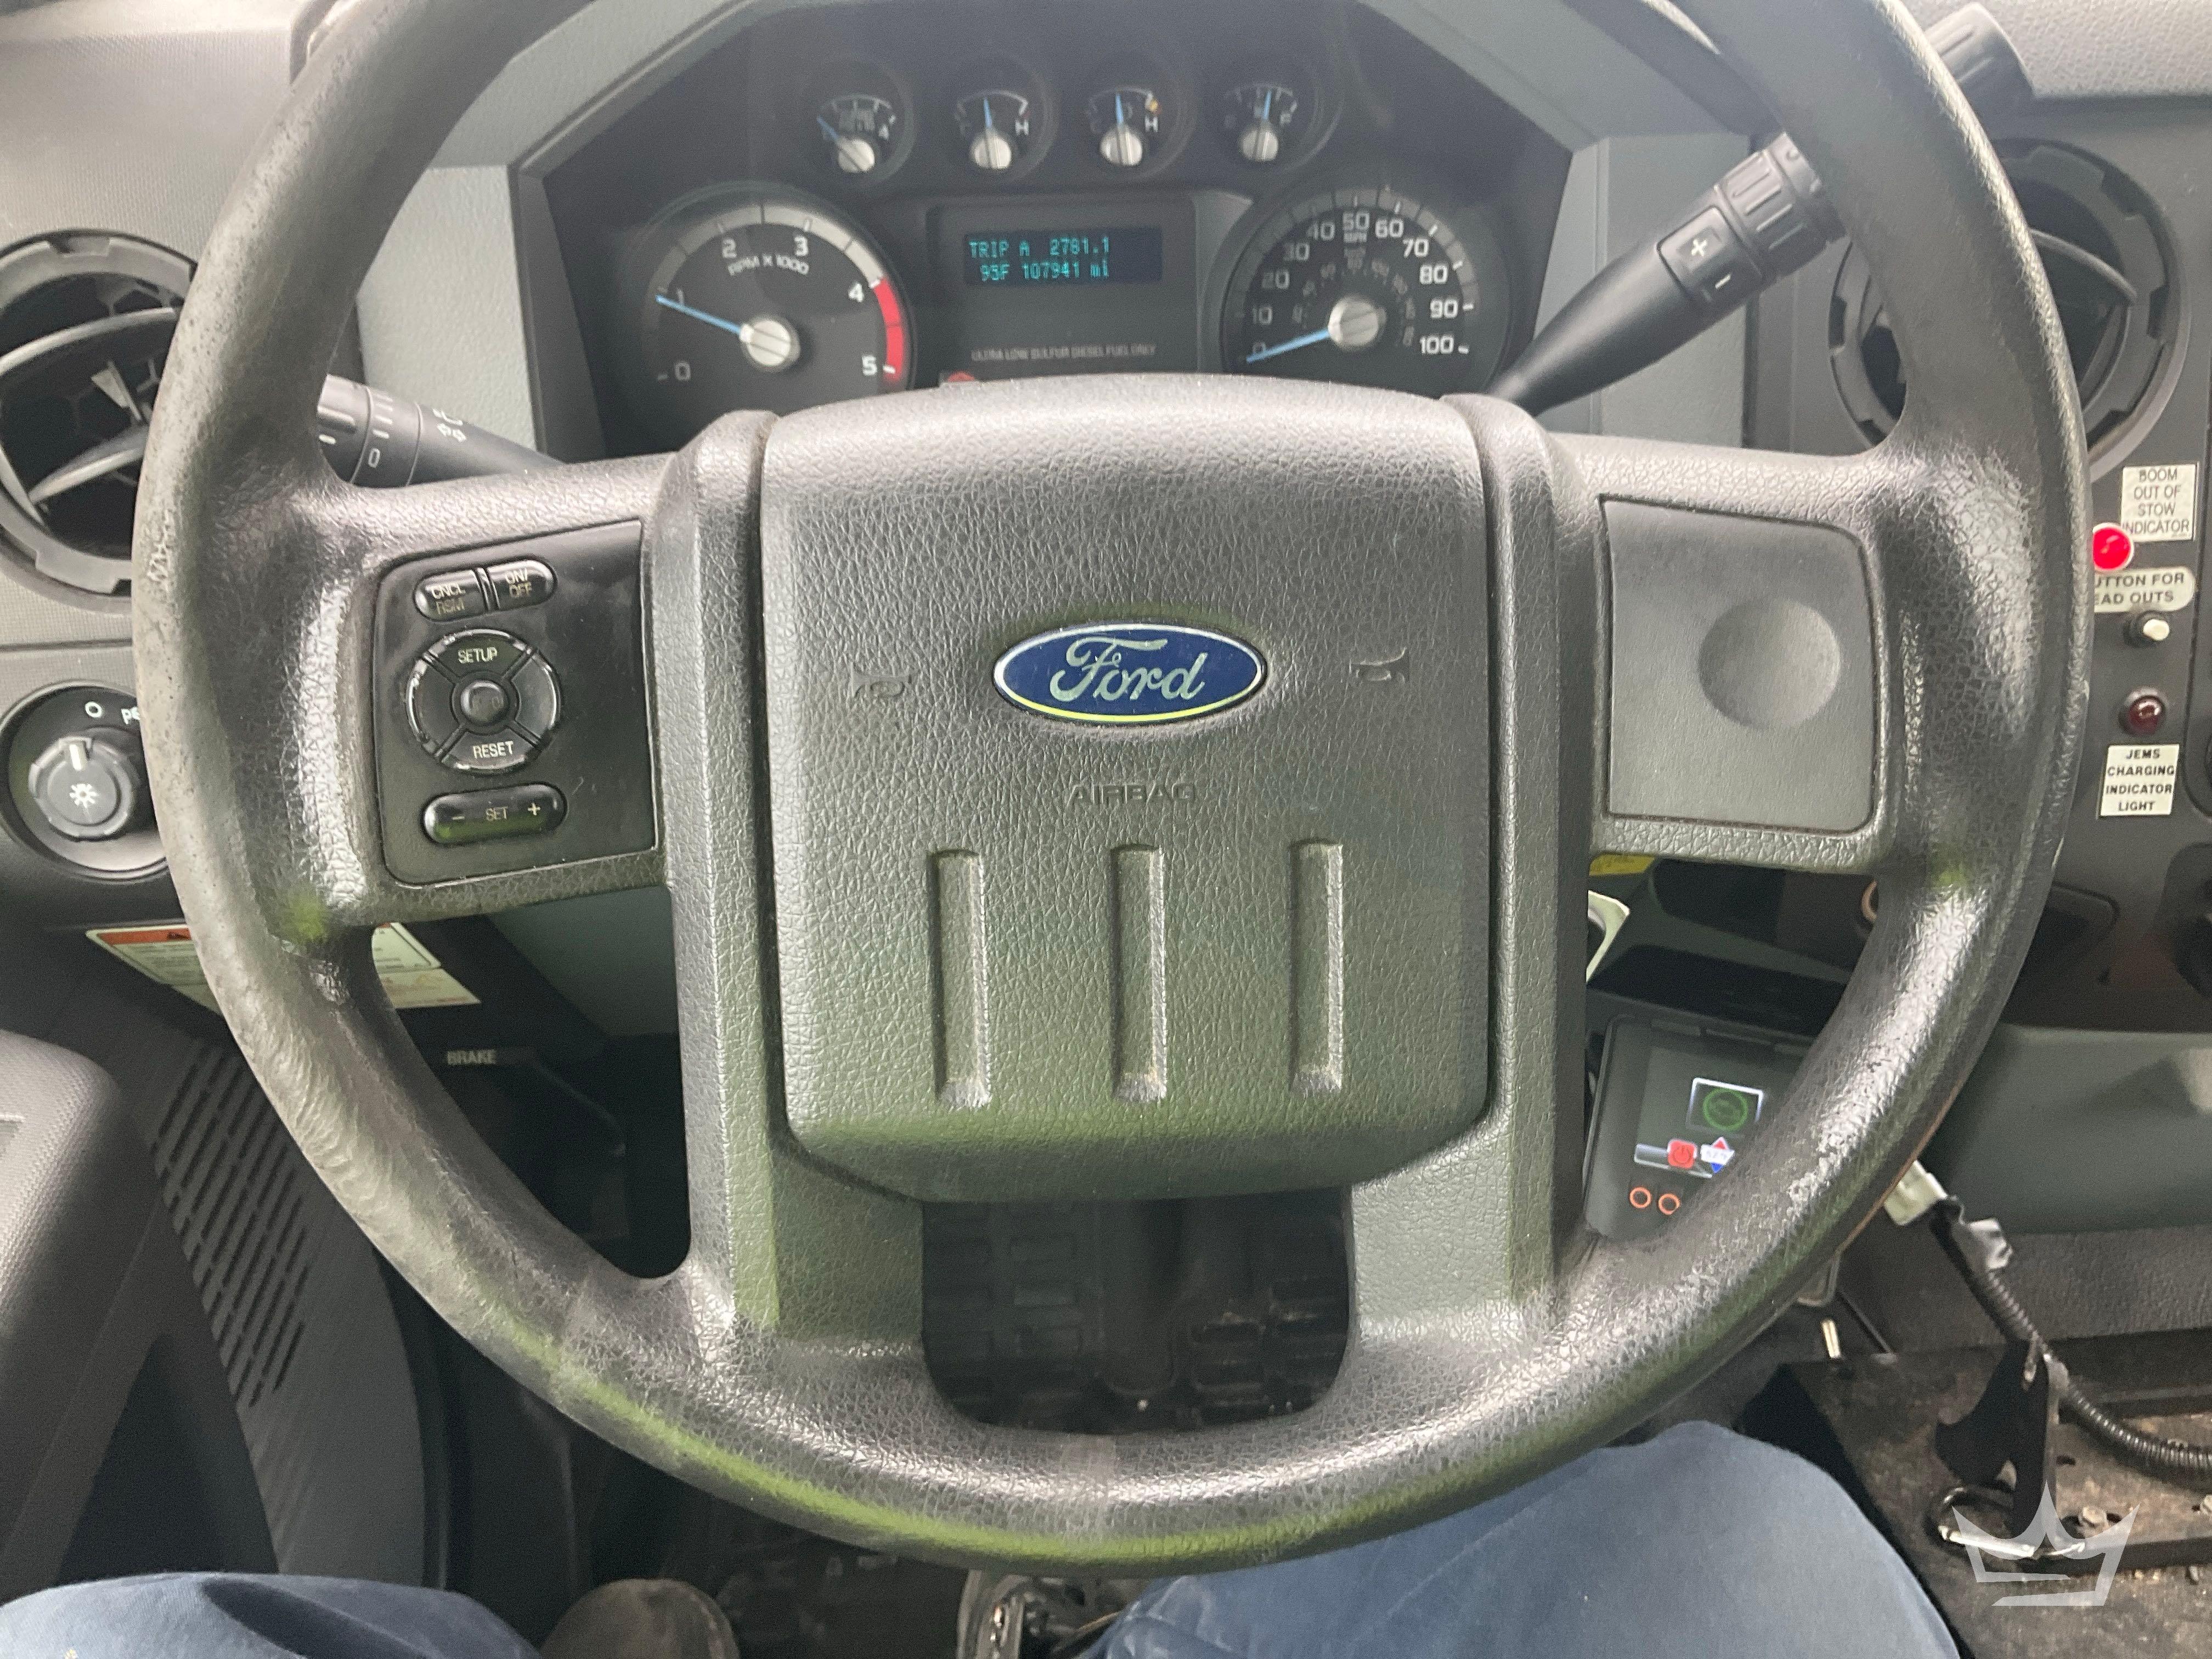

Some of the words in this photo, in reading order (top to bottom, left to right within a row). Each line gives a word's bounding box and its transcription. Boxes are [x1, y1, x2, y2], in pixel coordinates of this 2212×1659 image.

[1342, 211, 1370, 230] 50
[1375, 219, 1403, 238] 60
[722, 238, 737, 258] 2
[794, 235, 809, 256] 3
[969, 240, 1009, 258] TRIP
[1019, 240, 1030, 257] A
[1403, 238, 1429, 258] 70
[775, 253, 809, 275] 1000
[1090, 258, 1109, 278] mi
[1420, 264, 1448, 284] 80
[848, 283, 864, 302] 4
[1430, 299, 1458, 319] 90
[1420, 335, 1454, 355] 100
[675, 361, 691, 381] 0
[862, 356, 877, 375] 5
[2138, 468, 2178, 483] BOOM
[2134, 485, 2159, 500] OUT
[2164, 484, 2182, 499] OF
[2138, 501, 2176, 517] STOW
[509, 582, 532, 598] OFF
[2095, 574, 2146, 589] UTTON
[2152, 572, 2185, 586] FOR
[431, 583, 466, 599] CNCL
[2130, 590, 2174, 604] OUTS
[458, 646, 498, 664] SETUP
[1049, 636, 1208, 702] Ford
[472, 740, 514, 759] RESET
[2126, 748, 2160, 760] JEMS
[2108, 765, 2175, 777] CHARGING
[2106, 783, 2173, 795] INDICATOR
[486, 805, 509, 821] SET
[2118, 800, 2155, 812] LIGHT
